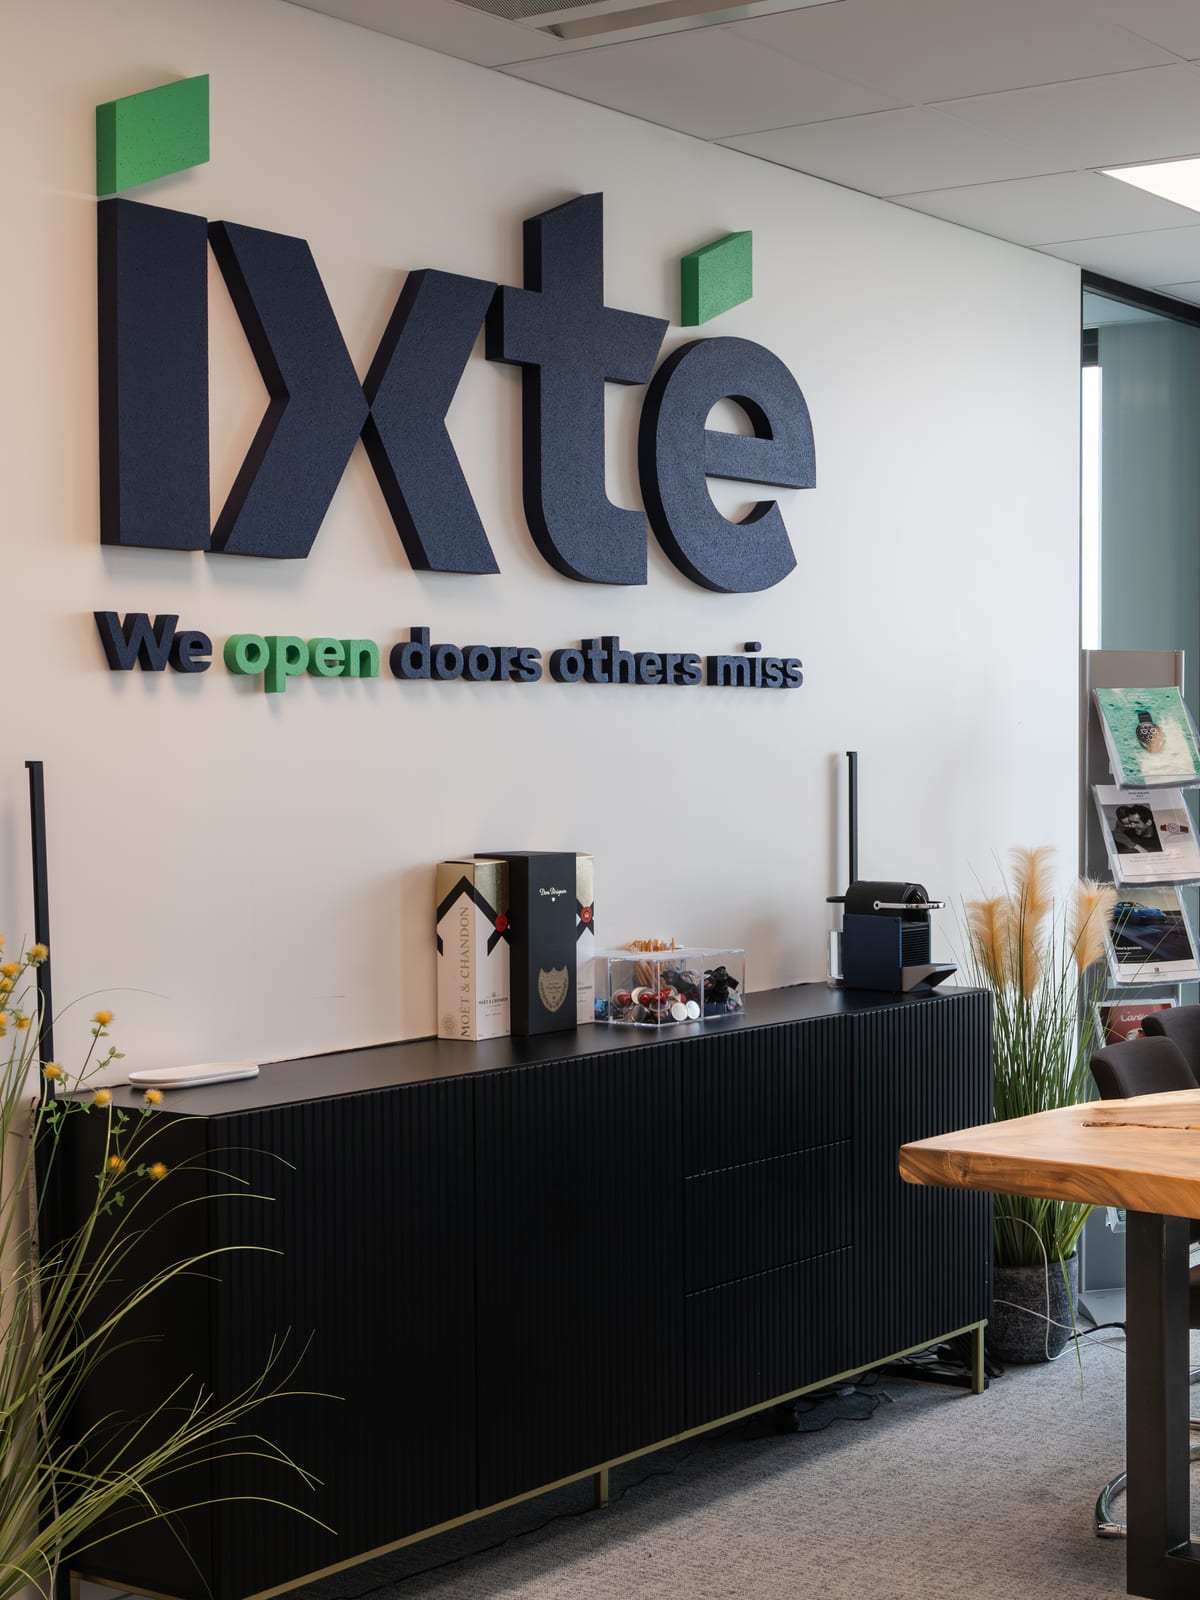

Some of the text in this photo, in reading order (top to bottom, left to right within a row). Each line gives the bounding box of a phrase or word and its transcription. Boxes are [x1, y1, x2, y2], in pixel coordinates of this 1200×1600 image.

[96, 73, 817, 594] ixté
[93, 611, 803, 693] We open doors others miss
[460, 906, 470, 979] CHANDON
[460, 983, 470, 993] &
